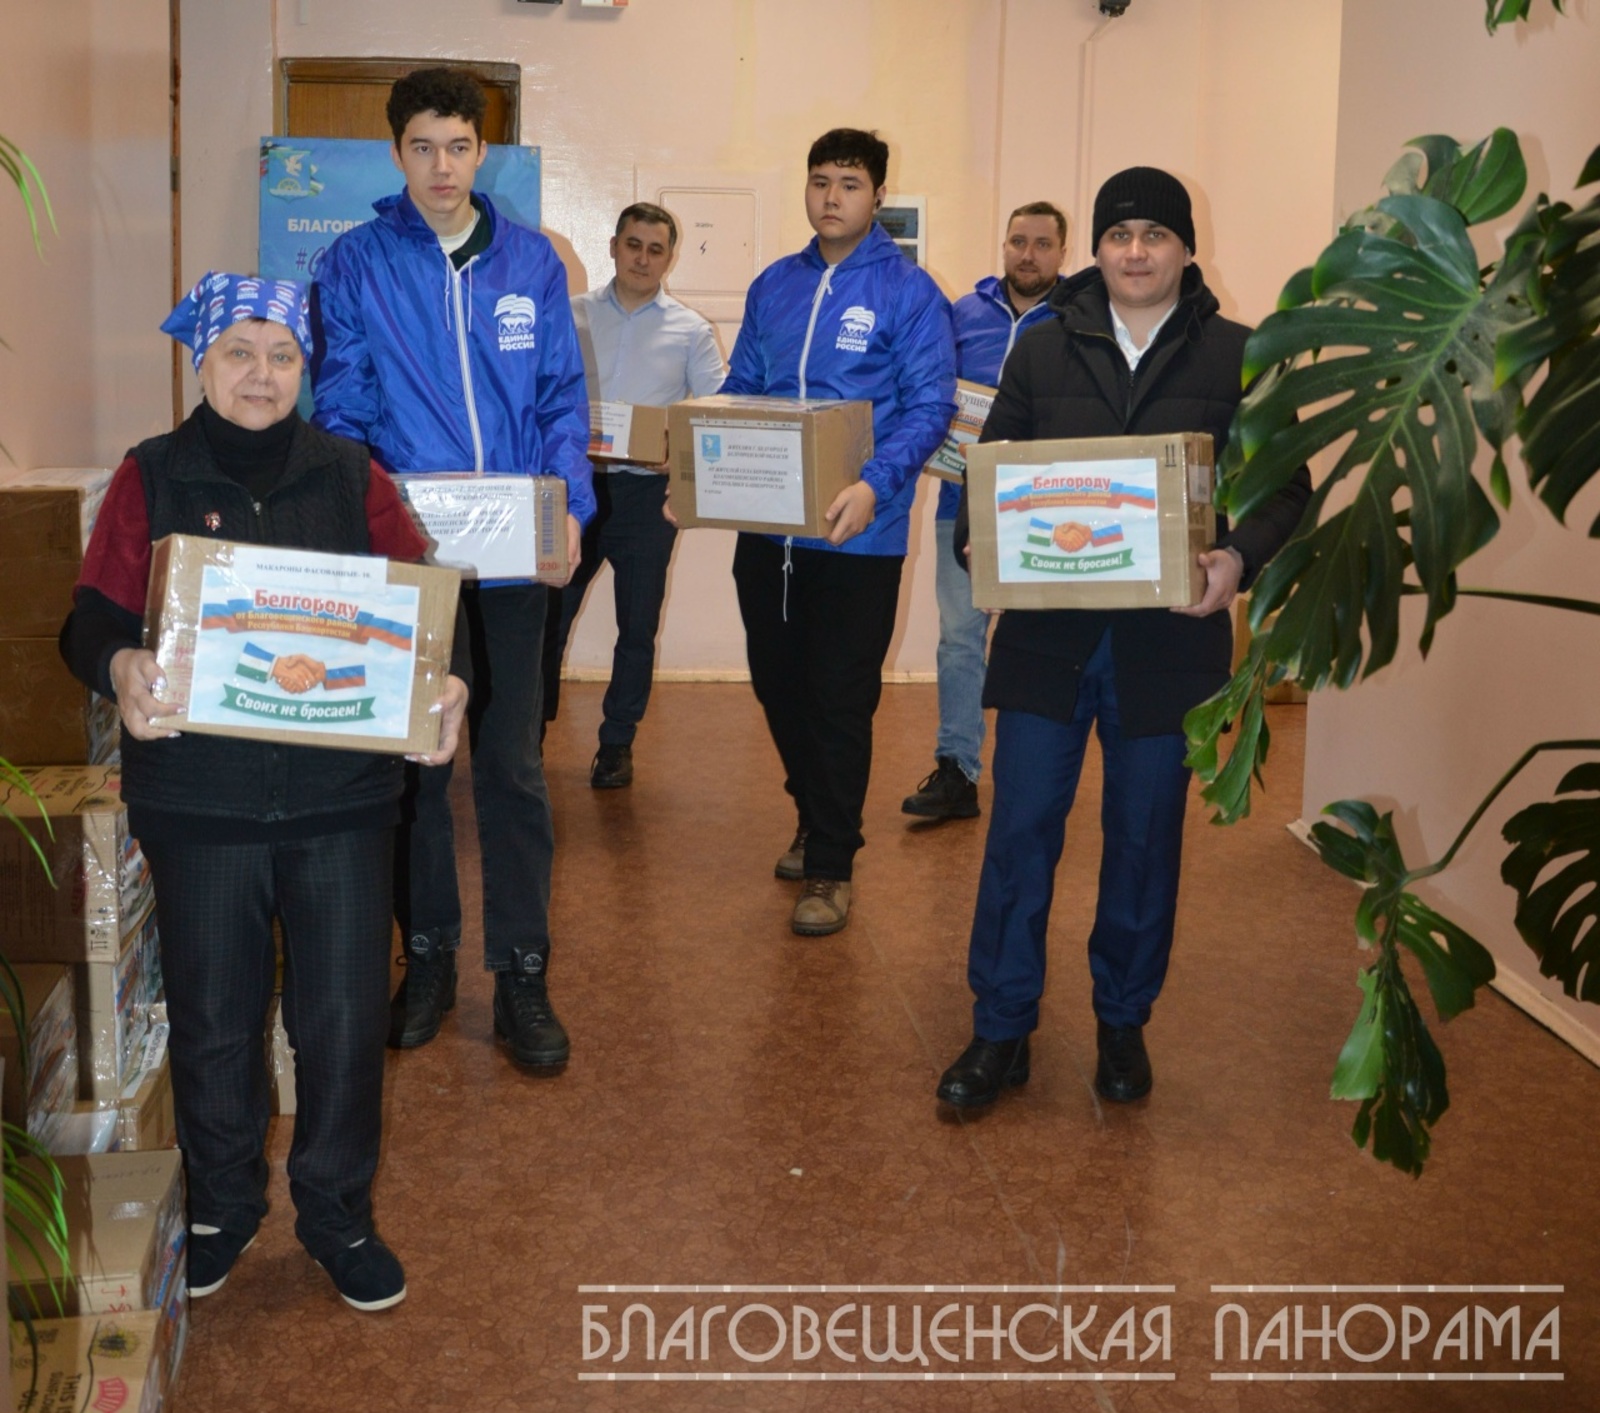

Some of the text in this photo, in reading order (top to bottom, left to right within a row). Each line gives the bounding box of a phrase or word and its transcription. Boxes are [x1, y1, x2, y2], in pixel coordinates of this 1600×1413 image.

[498, 333, 535, 343] ЕДИНАЯ
[499, 341, 535, 351] РОССИЯ
[837, 336, 868, 346] ЕДИНАЯ
[835, 342, 867, 353] РОССИЯ
[1033, 475, 1112, 491] Белгороду
[256, 563, 301, 573] МАКАРОНЫ
[1030, 553, 1123, 572] Своих не бросаем!
[254, 588, 360, 621] Белгороду
[235, 612, 246, 621] от
[326, 617, 358, 631] района
[235, 692, 362, 720] Своих не бросаем!
[59, 1373, 82, 1402] THIS
